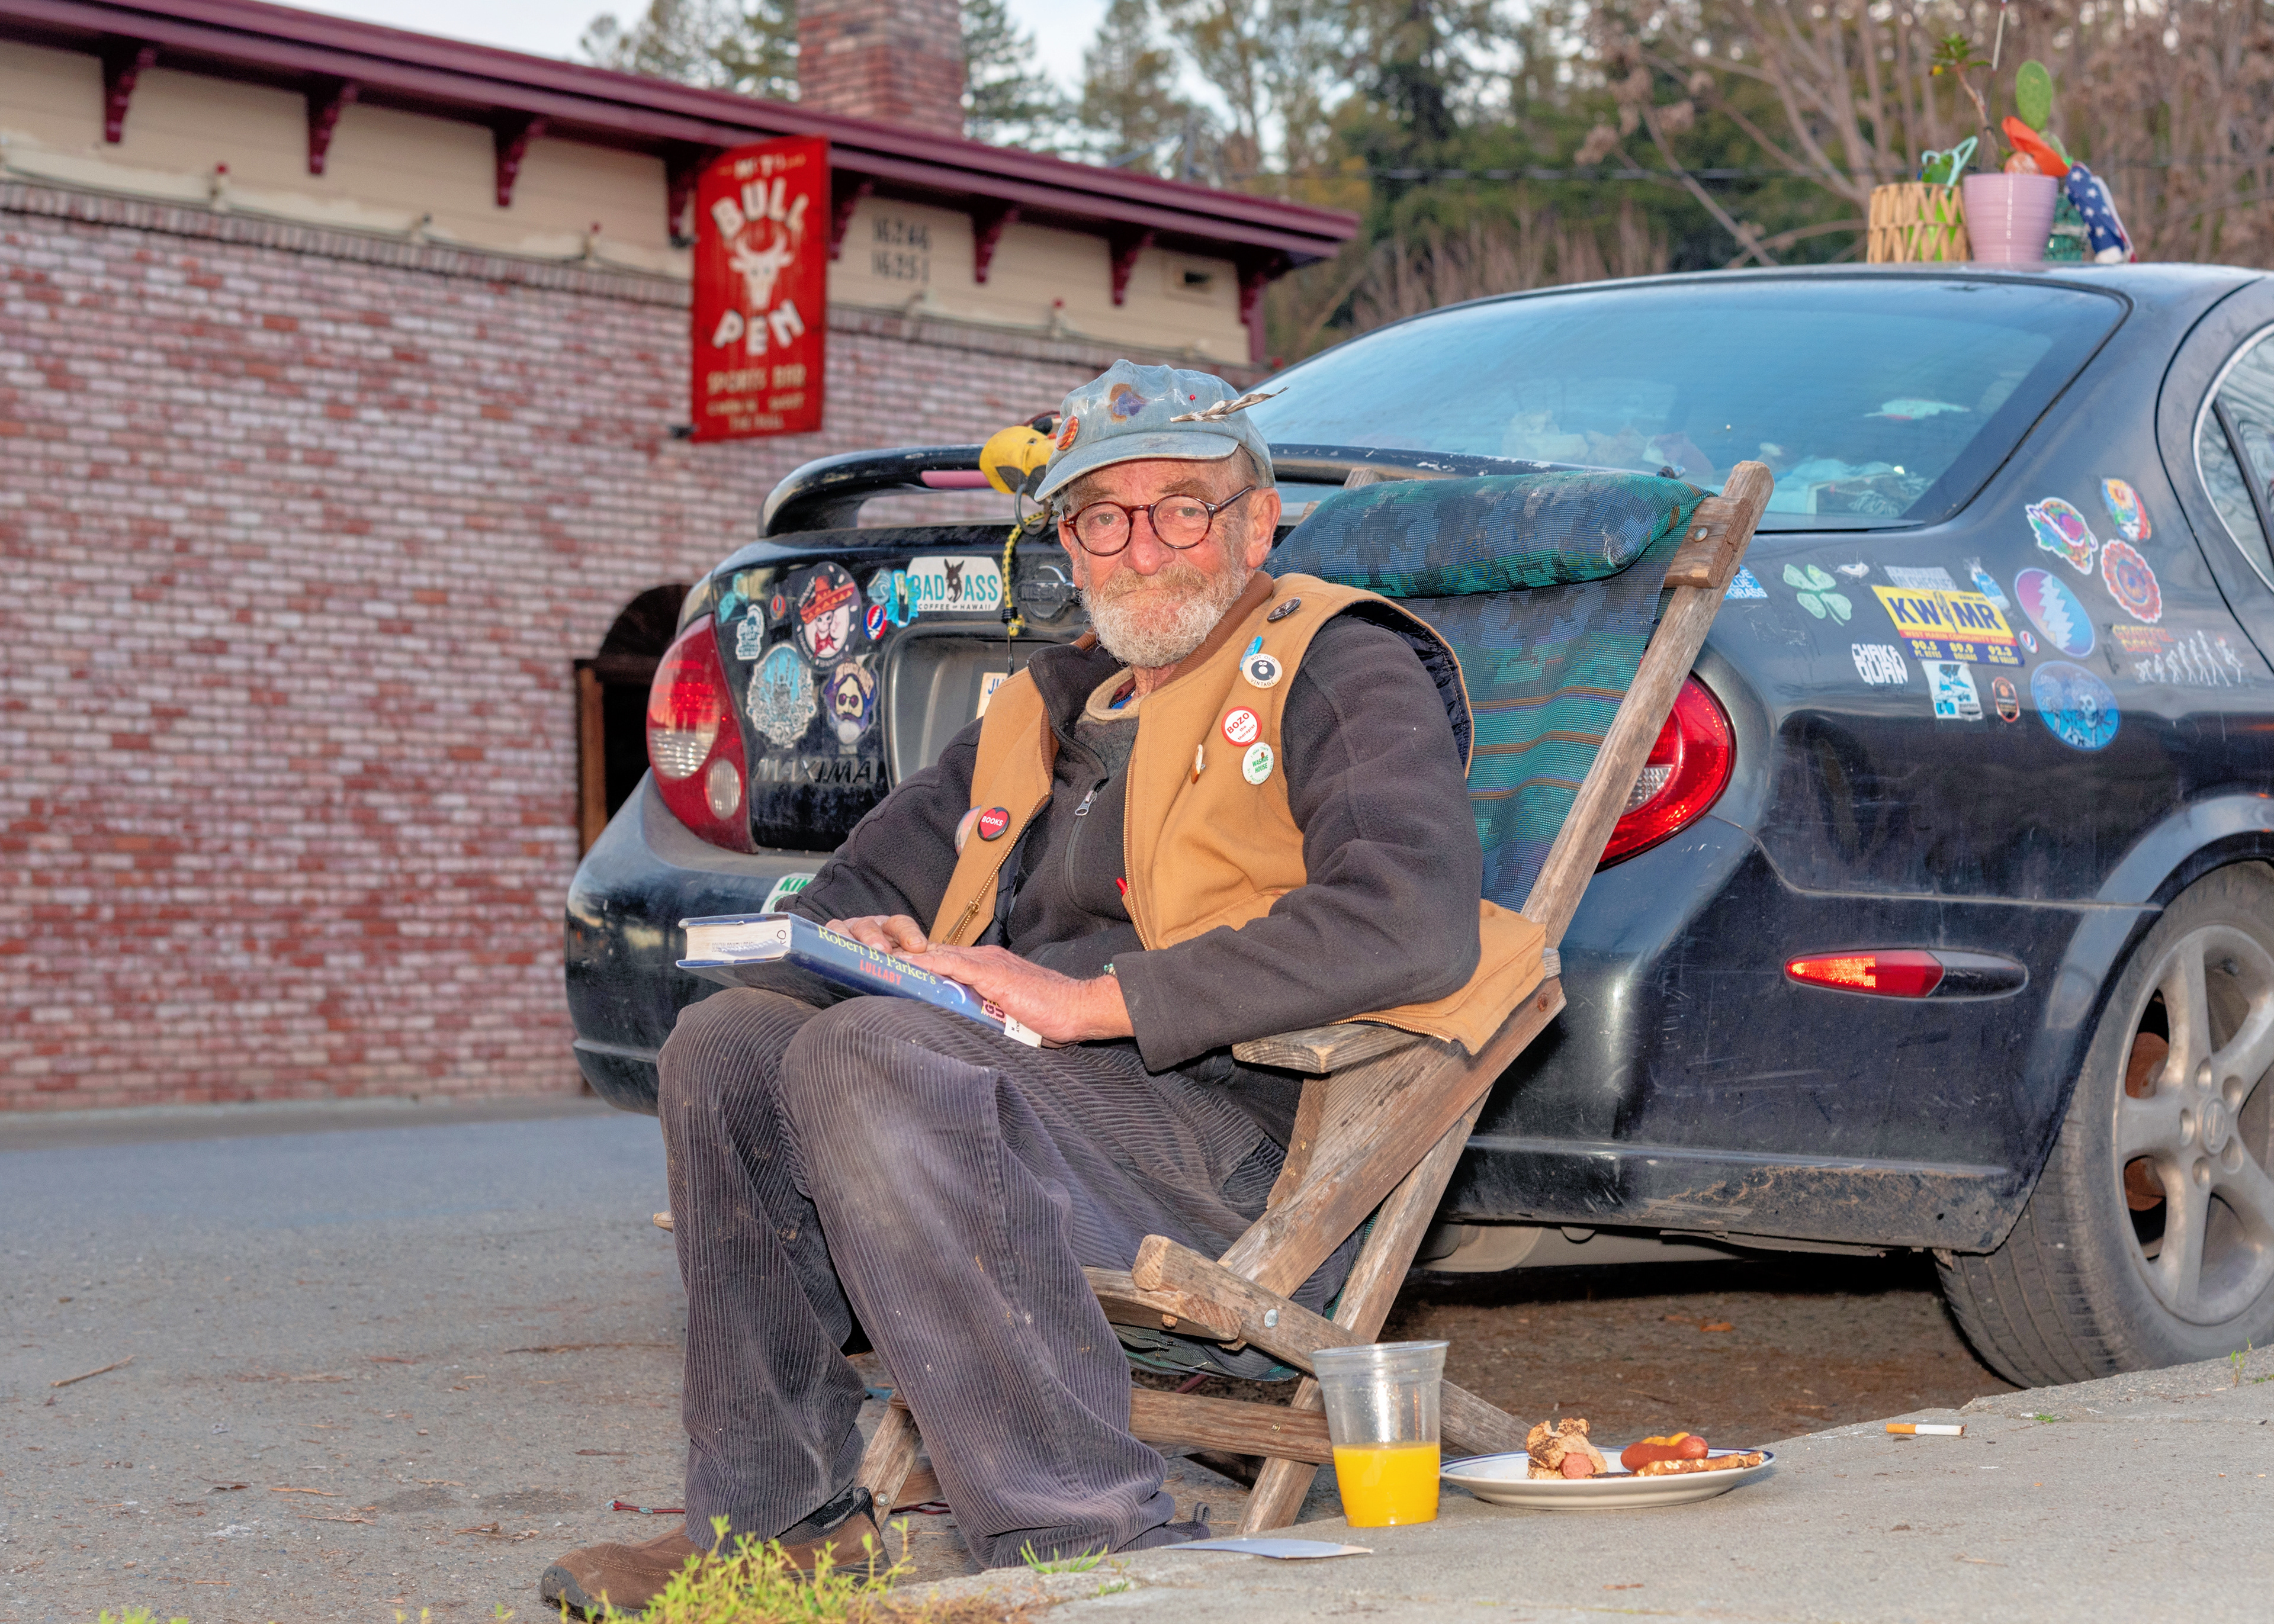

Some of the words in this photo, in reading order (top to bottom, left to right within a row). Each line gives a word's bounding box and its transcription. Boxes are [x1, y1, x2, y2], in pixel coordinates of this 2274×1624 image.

[712, 178, 809, 239] BULL
[712, 300, 804, 355] PEN
[963, 574, 998, 602] ASS
[1904, 630, 1925, 638] WEST
[1926, 631, 1948, 640] MARIN
[1948, 633, 1990, 643] COMMUNITY
[1991, 636, 2012, 645] RADIO
[1911, 639, 1938, 651] 90.5
[1851, 643, 1903, 663] CHAKA
[1925, 650, 1942, 658] REYES
[1949, 642, 1974, 654] 89.9
[1987, 645, 2013, 657] 92.3
[2121, 639, 2162, 654] DEAD
[1954, 652, 1978, 661] BOLINAS
[1988, 655, 1999, 663] THE
[1999, 655, 2019, 665] VALLEY
[1854, 660, 1908, 686] QUAN
[1226, 712, 1250, 734] BOZO
[1237, 724, 1256, 741] therapist
[754, 757, 878, 783] MAXIMA
[1254, 763, 1268, 773] HOUSE
[981, 815, 1004, 827] BOOKS
[817, 925, 865, 956] Robert
[868, 947, 883, 963] B.
[886, 953, 936, 985] Parker's
[859, 959, 902, 986] LULLABY
